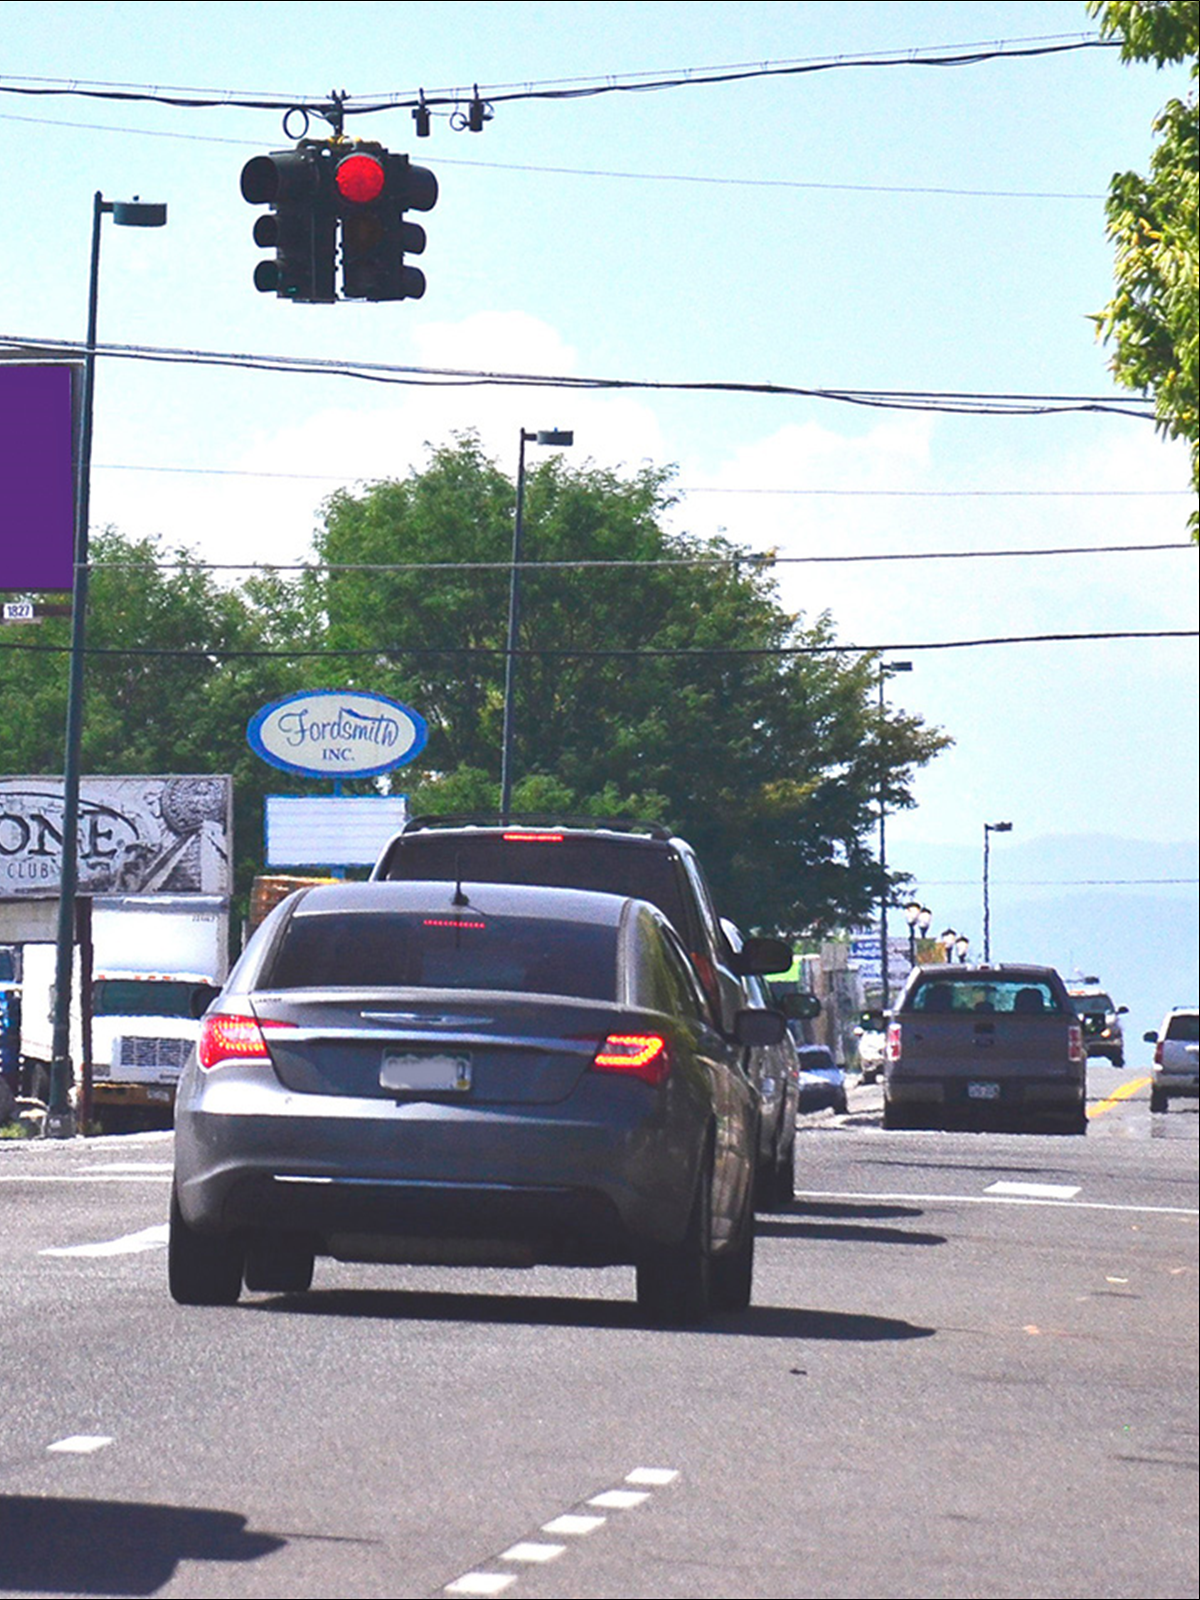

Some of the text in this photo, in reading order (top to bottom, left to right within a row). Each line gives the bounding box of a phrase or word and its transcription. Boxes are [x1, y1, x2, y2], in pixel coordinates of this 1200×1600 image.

[7, 604, 30, 617] 1827
[278, 706, 399, 747] Fordsmith
[322, 748, 355, 762] INC.
[7, 862, 49, 879] CLUB
